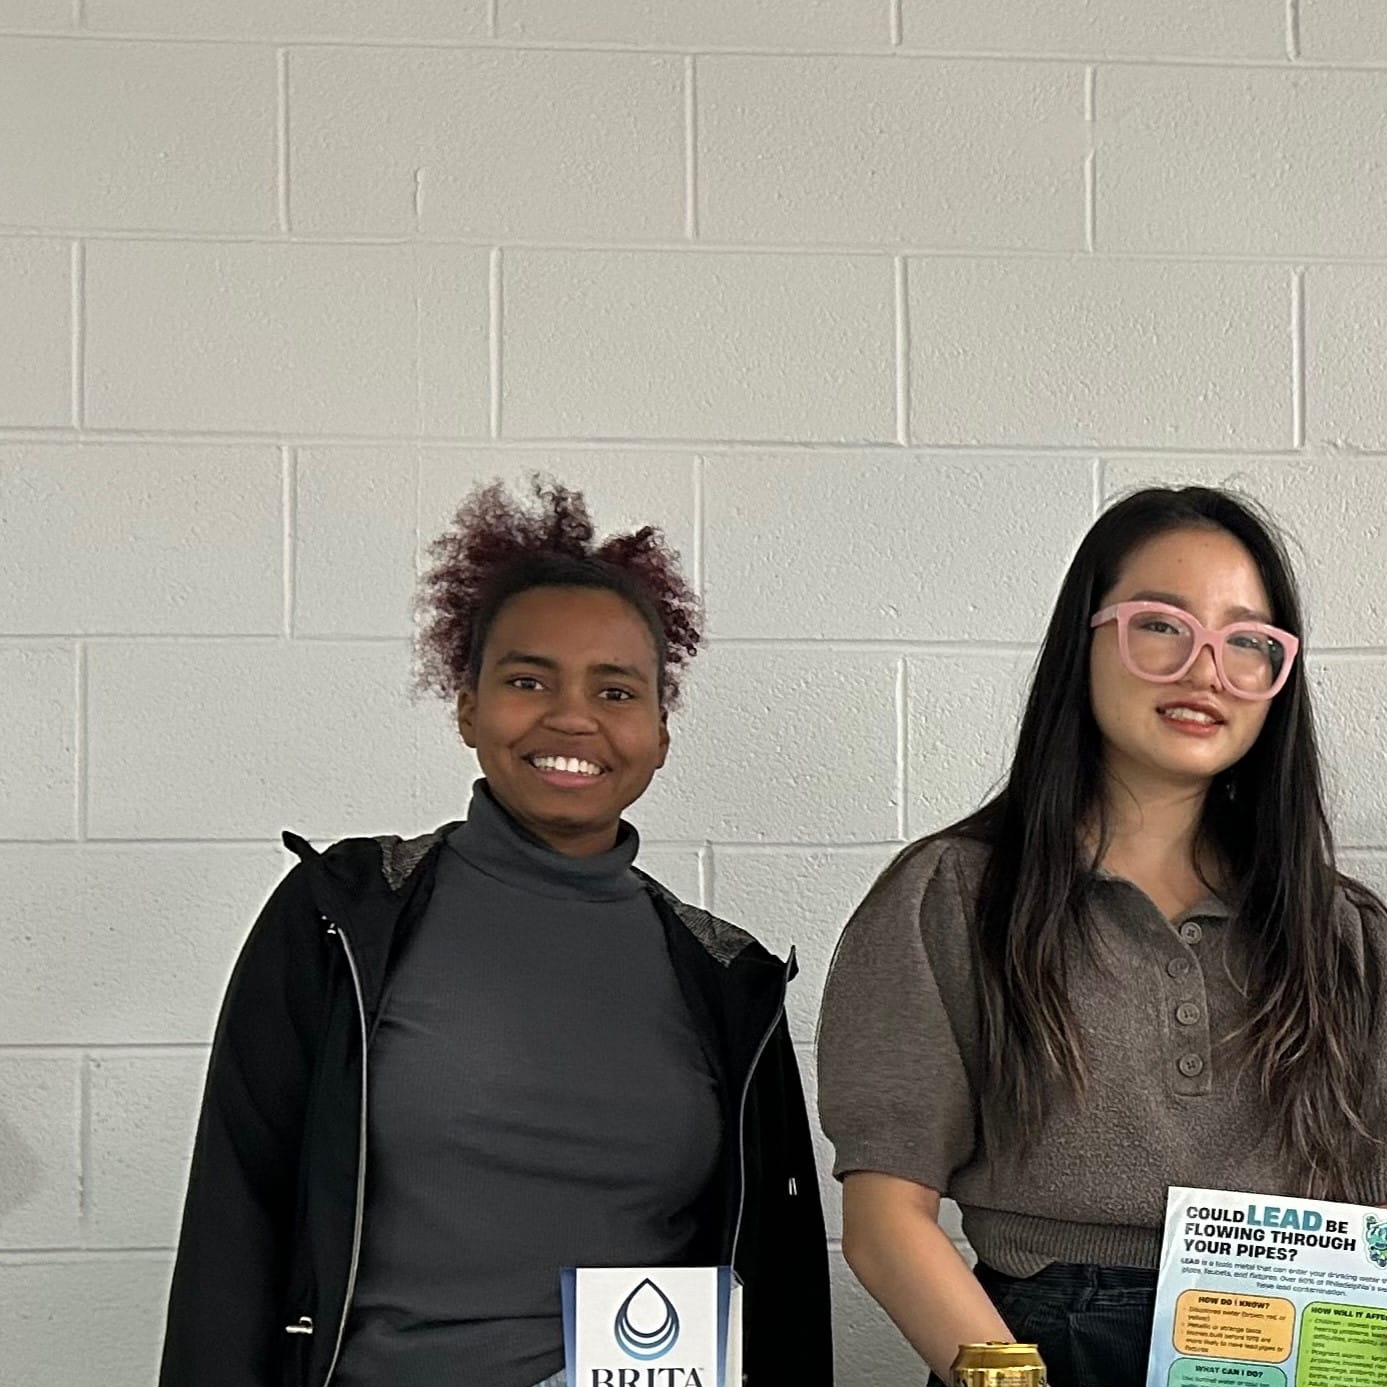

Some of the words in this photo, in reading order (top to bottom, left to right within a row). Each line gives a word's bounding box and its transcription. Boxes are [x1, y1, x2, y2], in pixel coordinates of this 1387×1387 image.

[1185, 1204, 1244, 1223] COULD
[1247, 1205, 1324, 1231] LEAD
[1325, 1219, 1348, 1234] BE
[1184, 1220, 1265, 1242] FLOWING
[1269, 1229, 1356, 1251] THROUGH
[1182, 1238, 1231, 1255] YOUR
[1236, 1243, 1297, 1262] PIPES?
[1180, 1256, 1199, 1264] LEAD
[1234, 1262, 1254, 1270] metal
[1327, 1272, 1357, 1282] drinking
[1198, 1295, 1218, 1304] HOW
[1220, 1298, 1232, 1306] DO
[1239, 1300, 1270, 1310] KNOW?
[1333, 1309, 1353, 1317] WILL
[1195, 1364, 1218, 1373] WHAT
[1221, 1367, 1239, 1375] CAN
